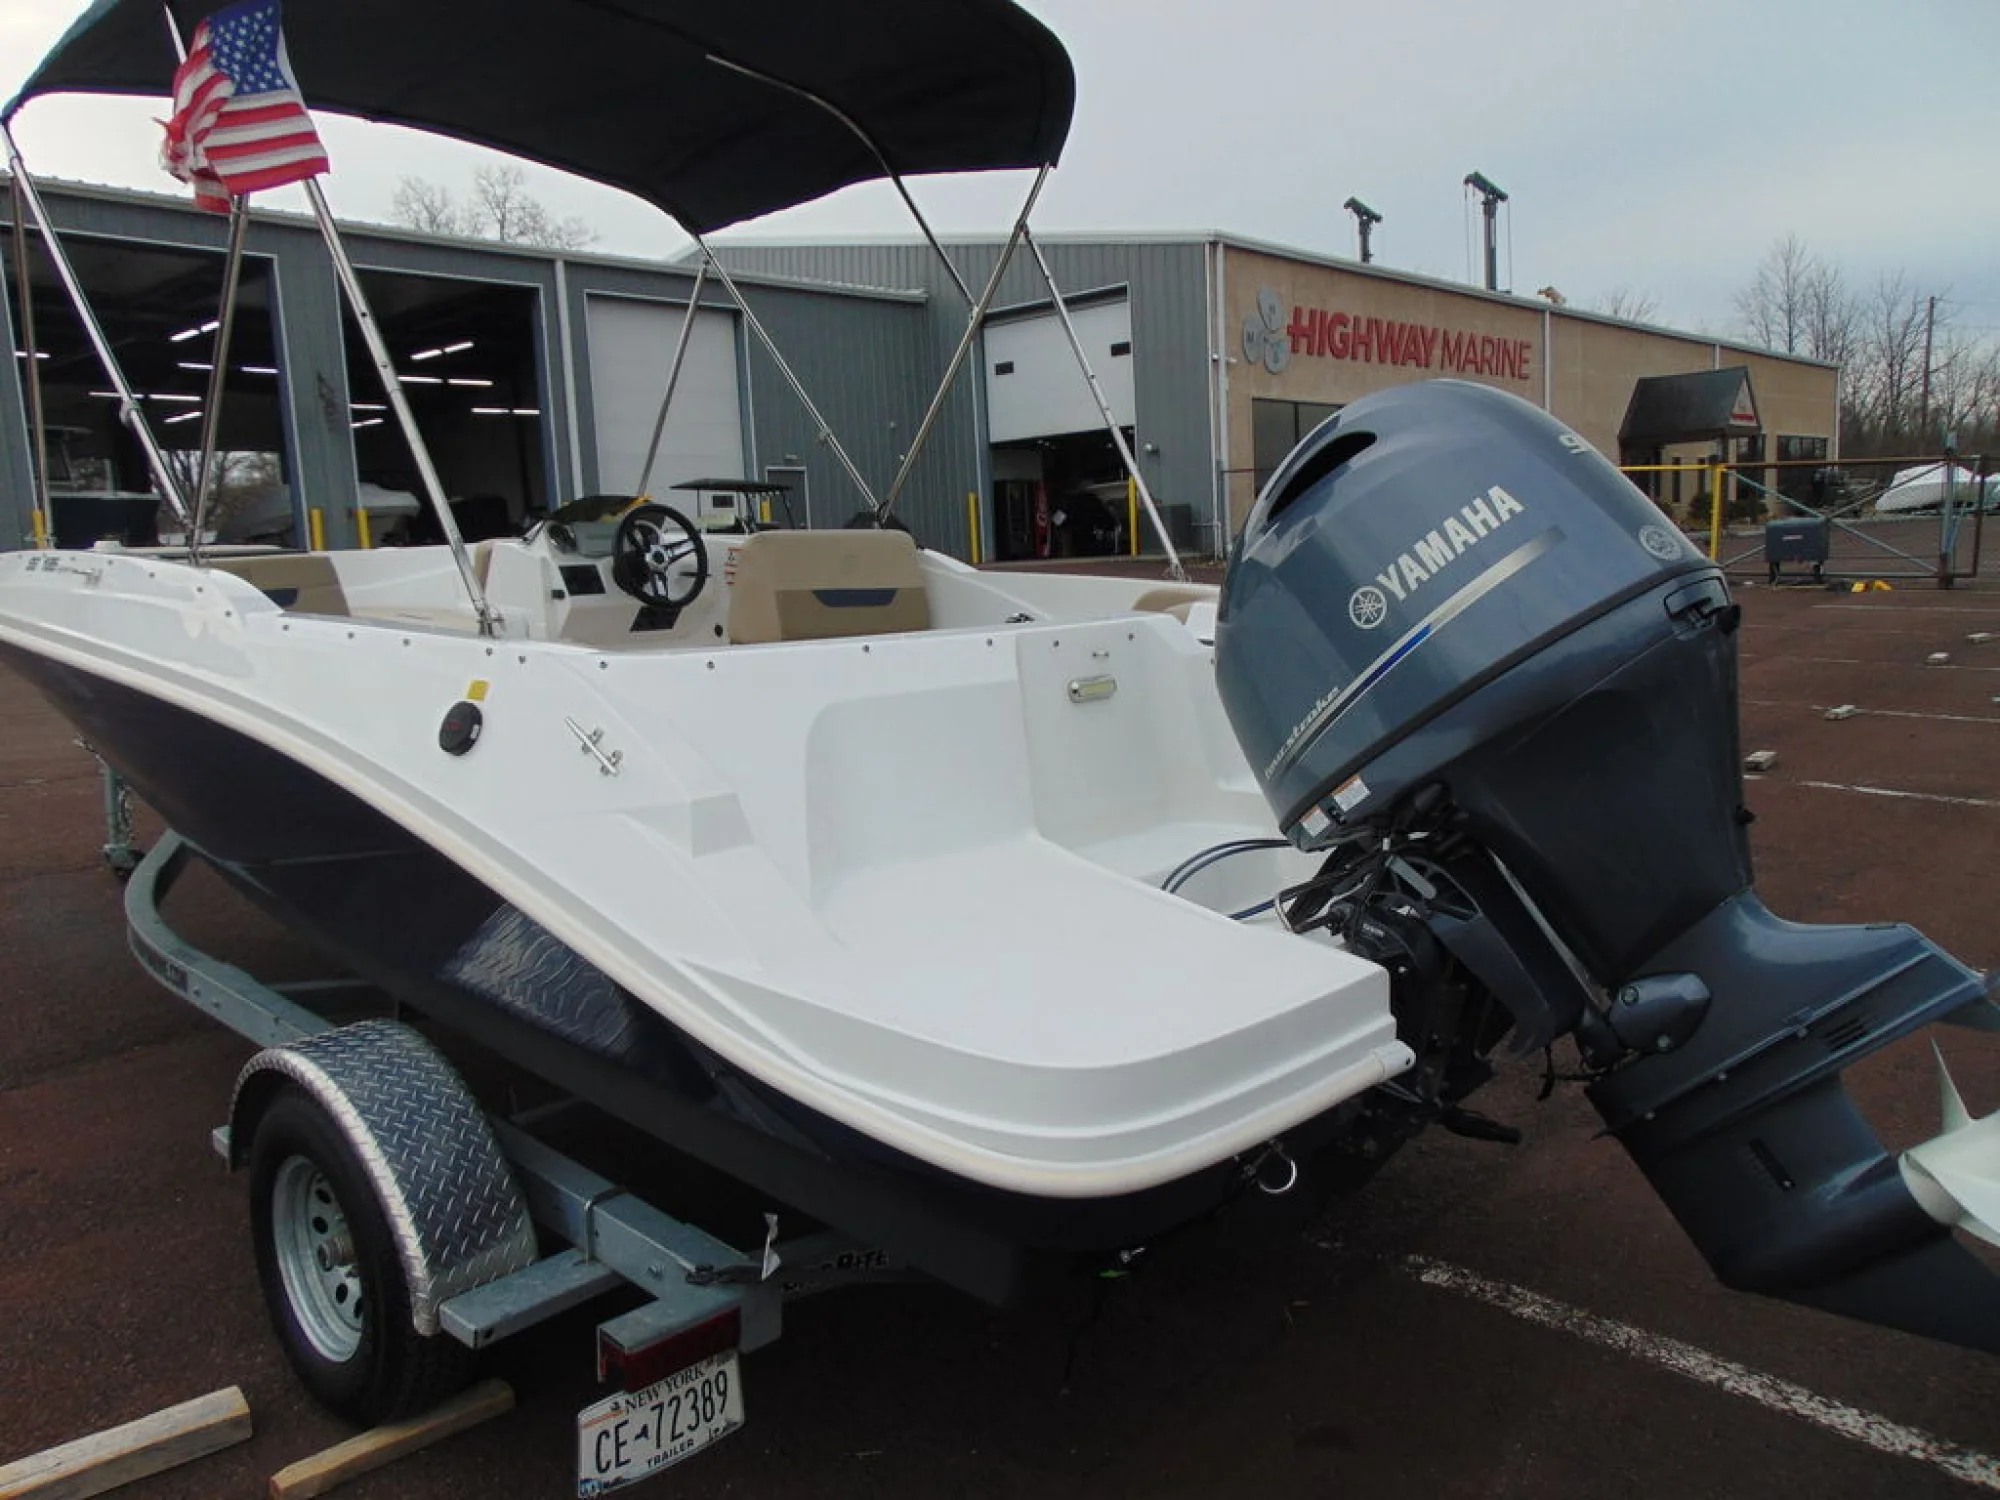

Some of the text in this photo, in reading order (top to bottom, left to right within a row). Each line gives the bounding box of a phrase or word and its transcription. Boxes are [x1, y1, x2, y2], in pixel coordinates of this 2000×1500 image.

[1287, 305, 1439, 368] HIGHWAY
[1440, 328, 1532, 380] MARINE
[1375, 484, 1525, 601] YAMAHA
[595, 1368, 728, 1474] CE 72389
[625, 1366, 703, 1414] NEW YORK
[647, 1437, 695, 1468] TRAILER
